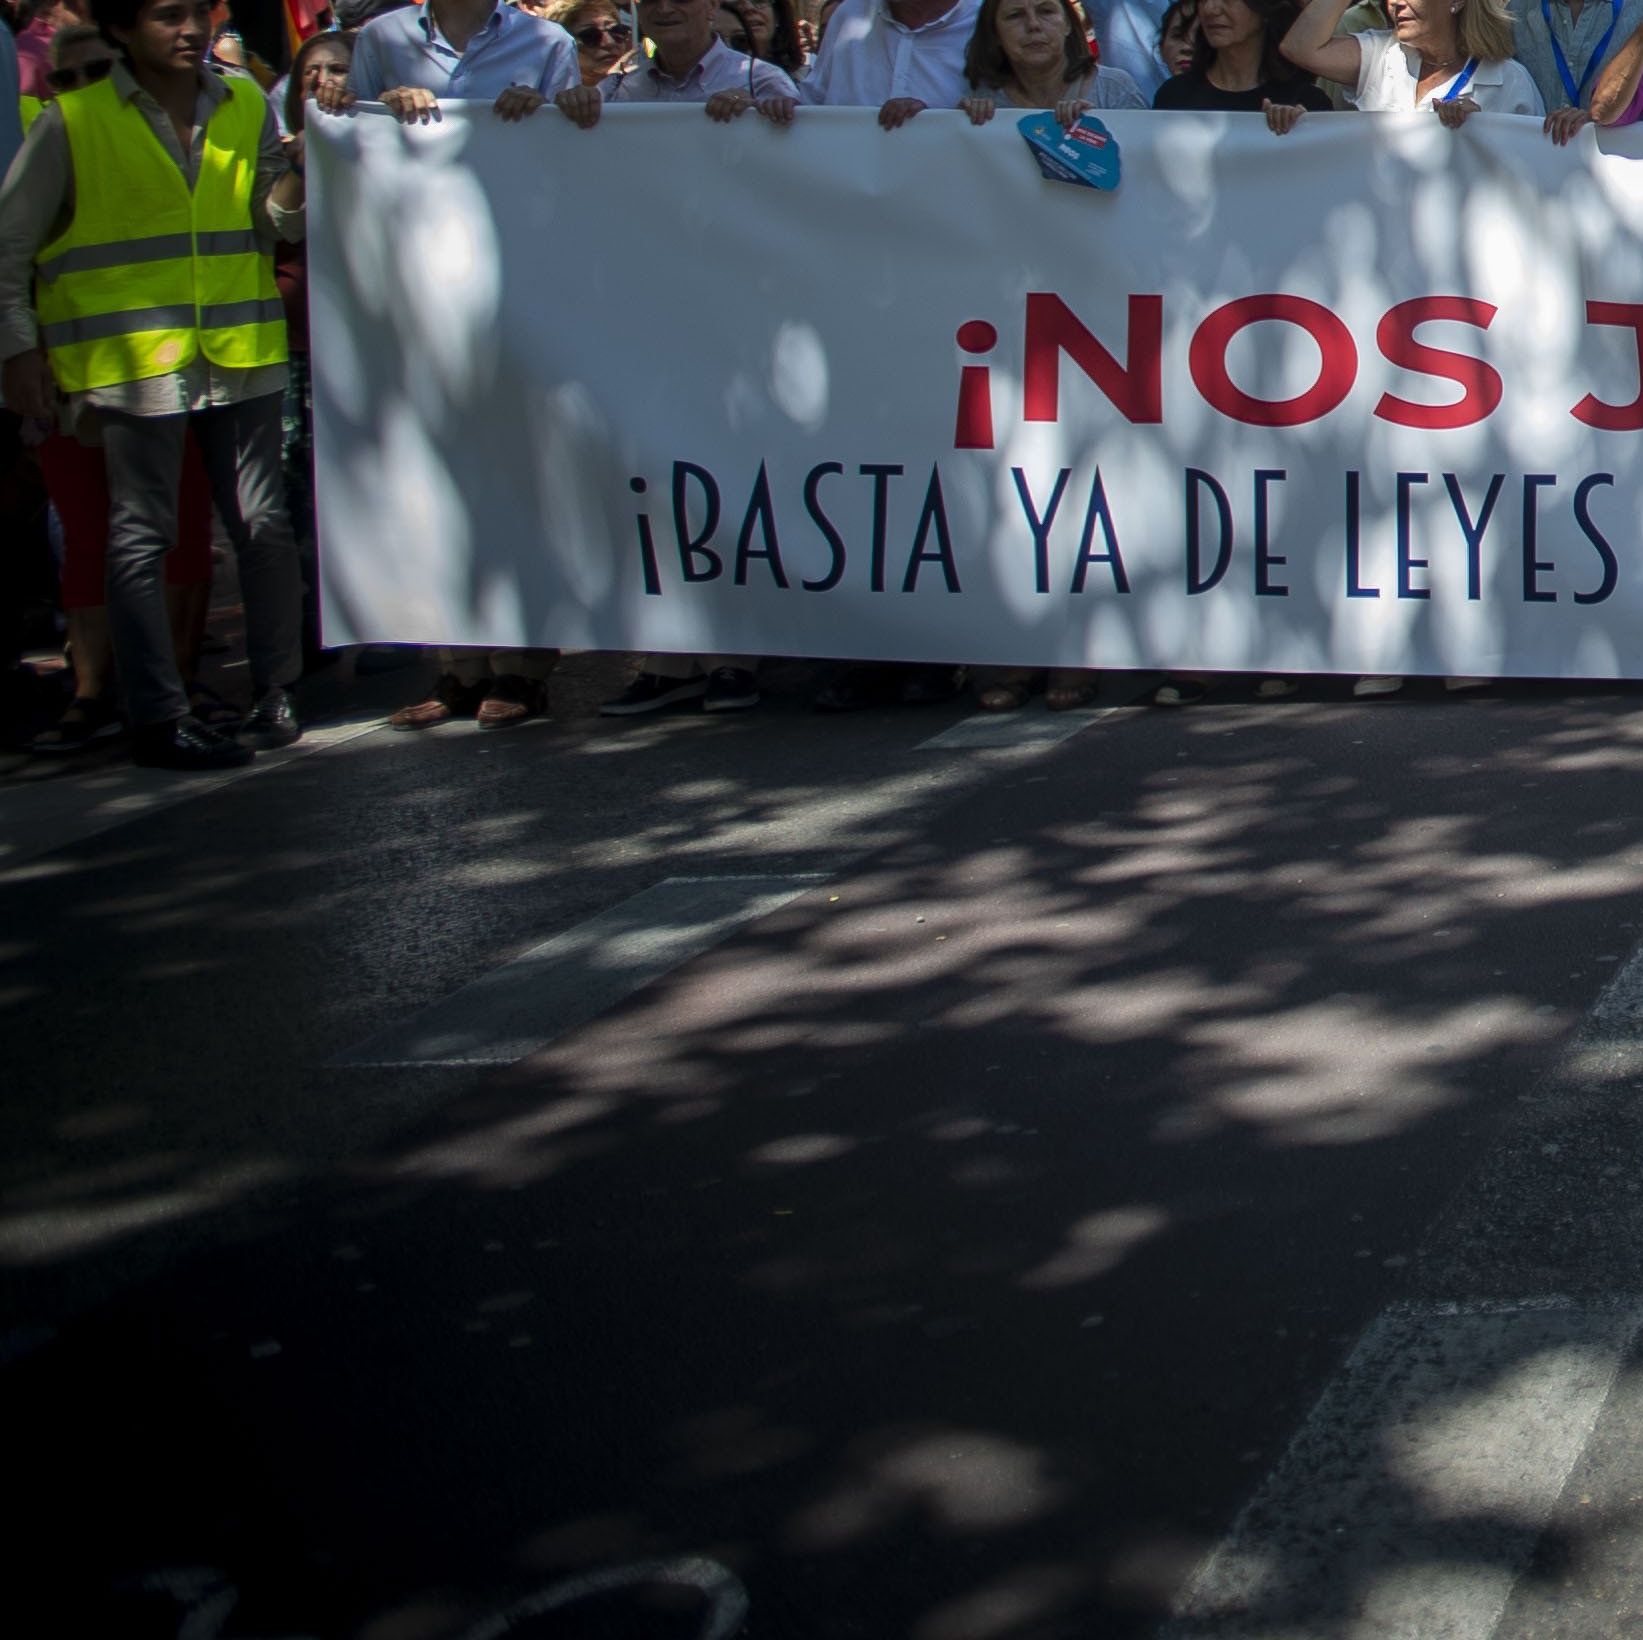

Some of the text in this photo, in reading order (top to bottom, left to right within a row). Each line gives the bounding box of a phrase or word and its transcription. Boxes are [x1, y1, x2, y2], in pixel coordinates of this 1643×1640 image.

[954, 292, 1505, 450] ¡NOS
[628, 457, 963, 595] ¡BASTA
[1010, 462, 1132, 595] YA
[1185, 466, 1290, 597] DE
[1345, 469, 1620, 606] LEYES
